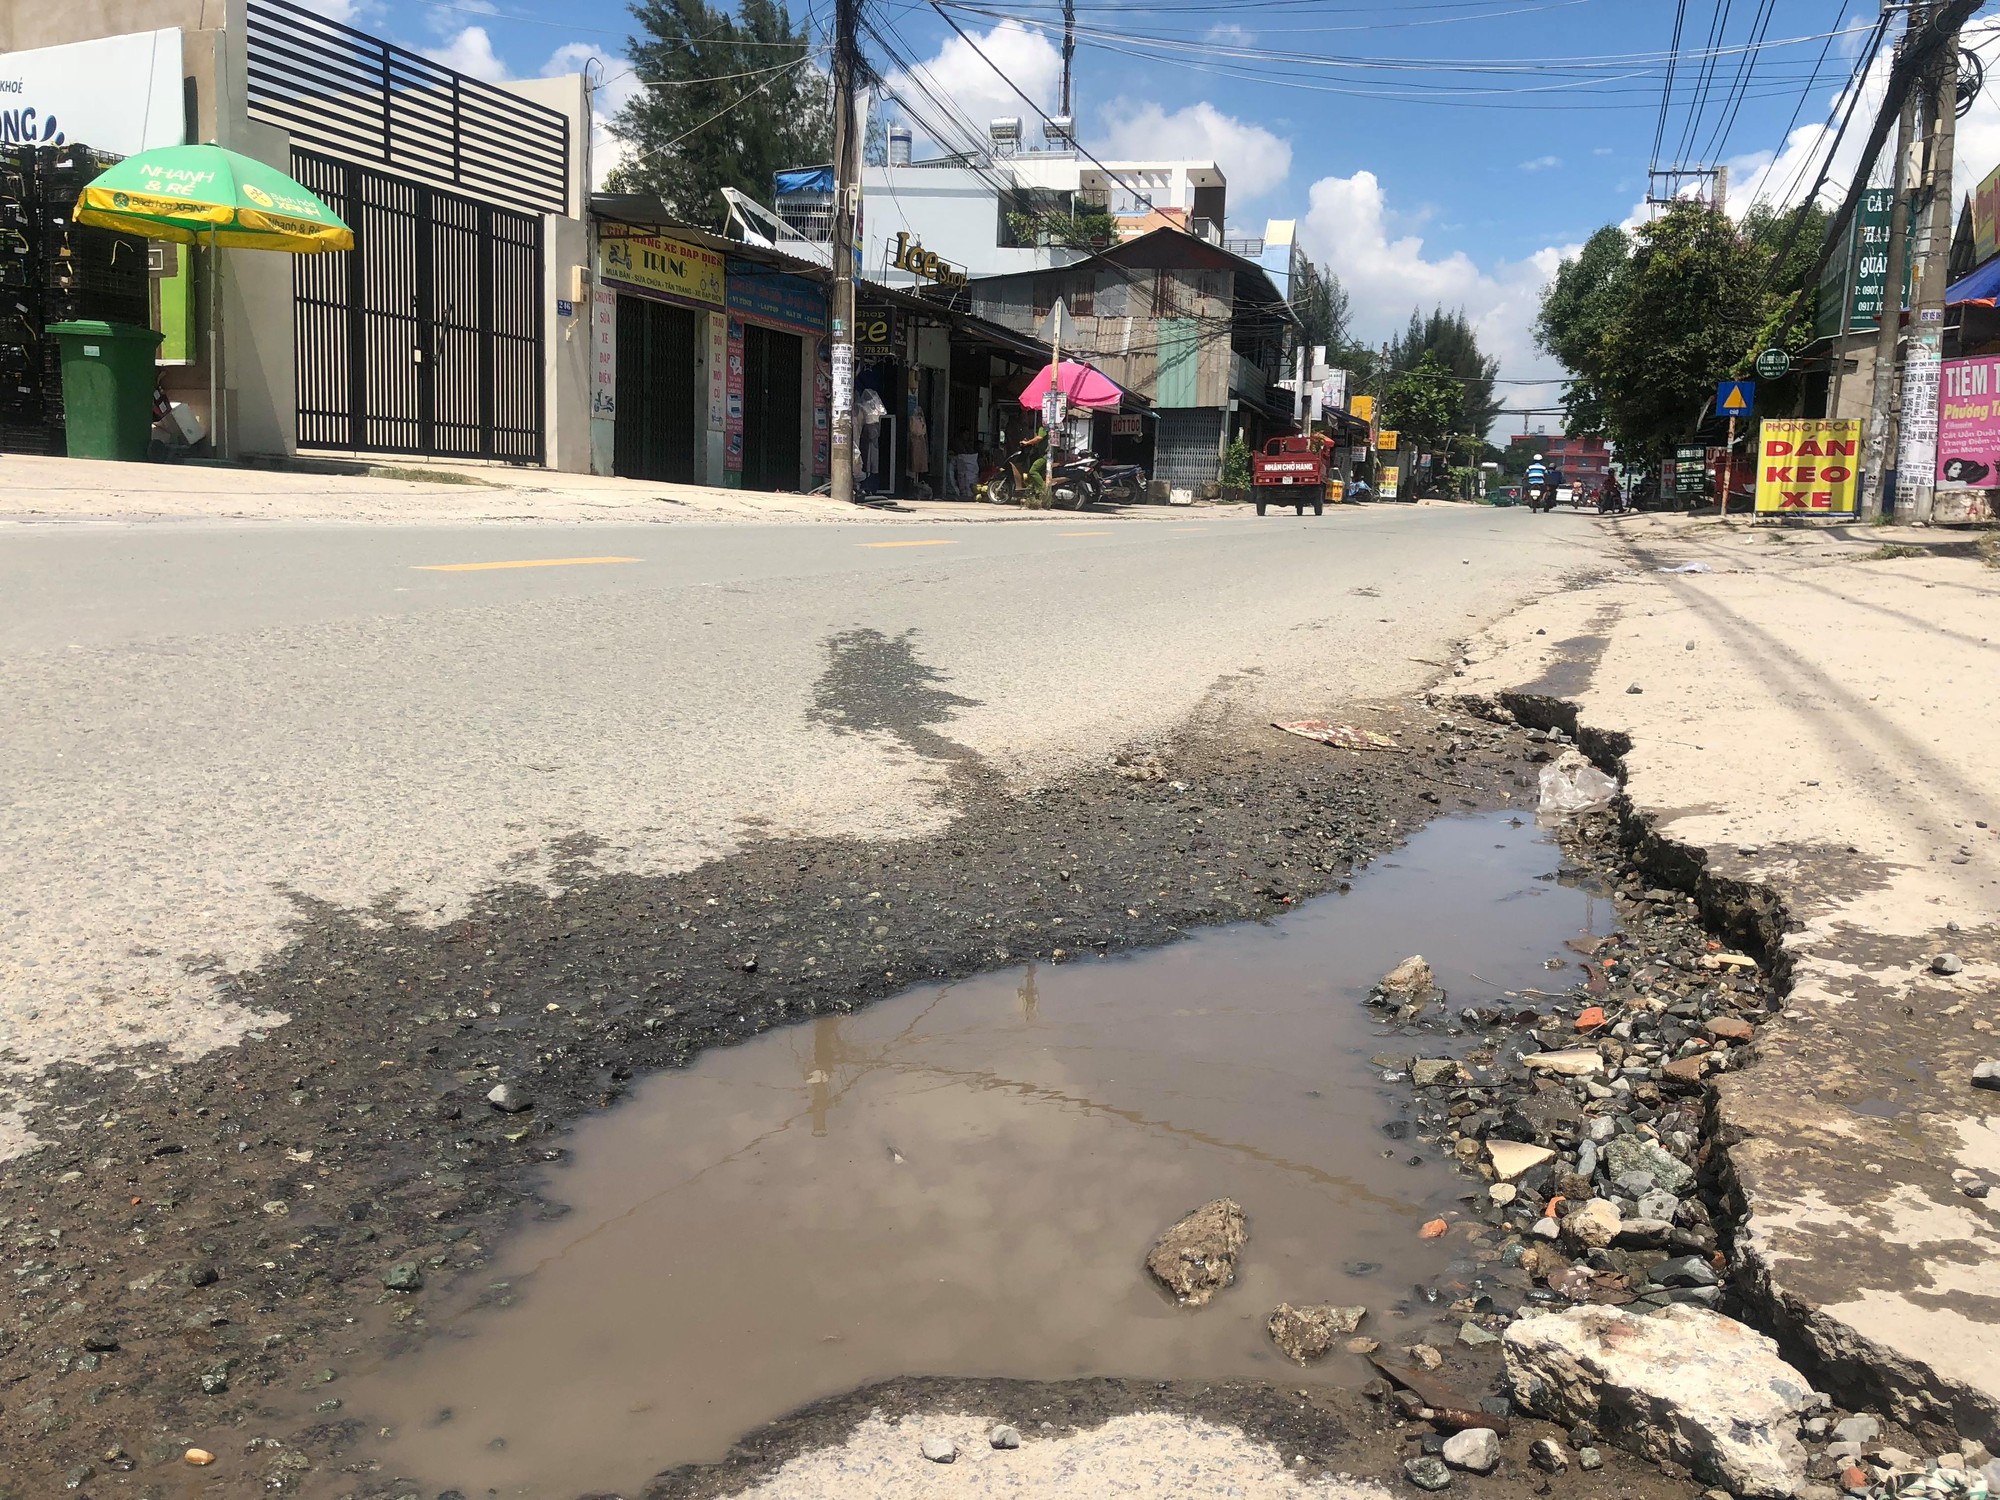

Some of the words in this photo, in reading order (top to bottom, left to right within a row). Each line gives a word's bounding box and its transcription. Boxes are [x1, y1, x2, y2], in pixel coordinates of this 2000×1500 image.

[0, 107, 37, 143] NG
[140, 164, 216, 183] NHANH
[144, 180, 161, 192] &
[664, 242, 677, 254] XE
[893, 231, 939, 280] Ice
[642, 249, 688, 278] TRUNG
[606, 267, 619, 276] MUA
[675, 284, 692, 296] TRANG
[937, 262, 969, 292] Shop
[1862, 286, 1878, 295] 0907
[558, 301, 571, 310] 246
[1858, 302, 1875, 312] 0917
[600, 311, 611, 325] SỬA
[712, 316, 725, 329] TRAO
[602, 332, 609, 344] XE
[855, 320, 888, 342] ce
[600, 354, 611, 367] ĐẠP
[714, 353, 721, 364] XE
[598, 370, 612, 386] ĐIỆN
[1946, 360, 1988, 403] TIỆM
[1766, 422, 1812, 432] PHONG
[1816, 422, 1858, 432] DECAL
[1766, 434, 1856, 457] DÁN
[1766, 466, 1851, 483] KEO
[1778, 492, 1833, 508] XE
